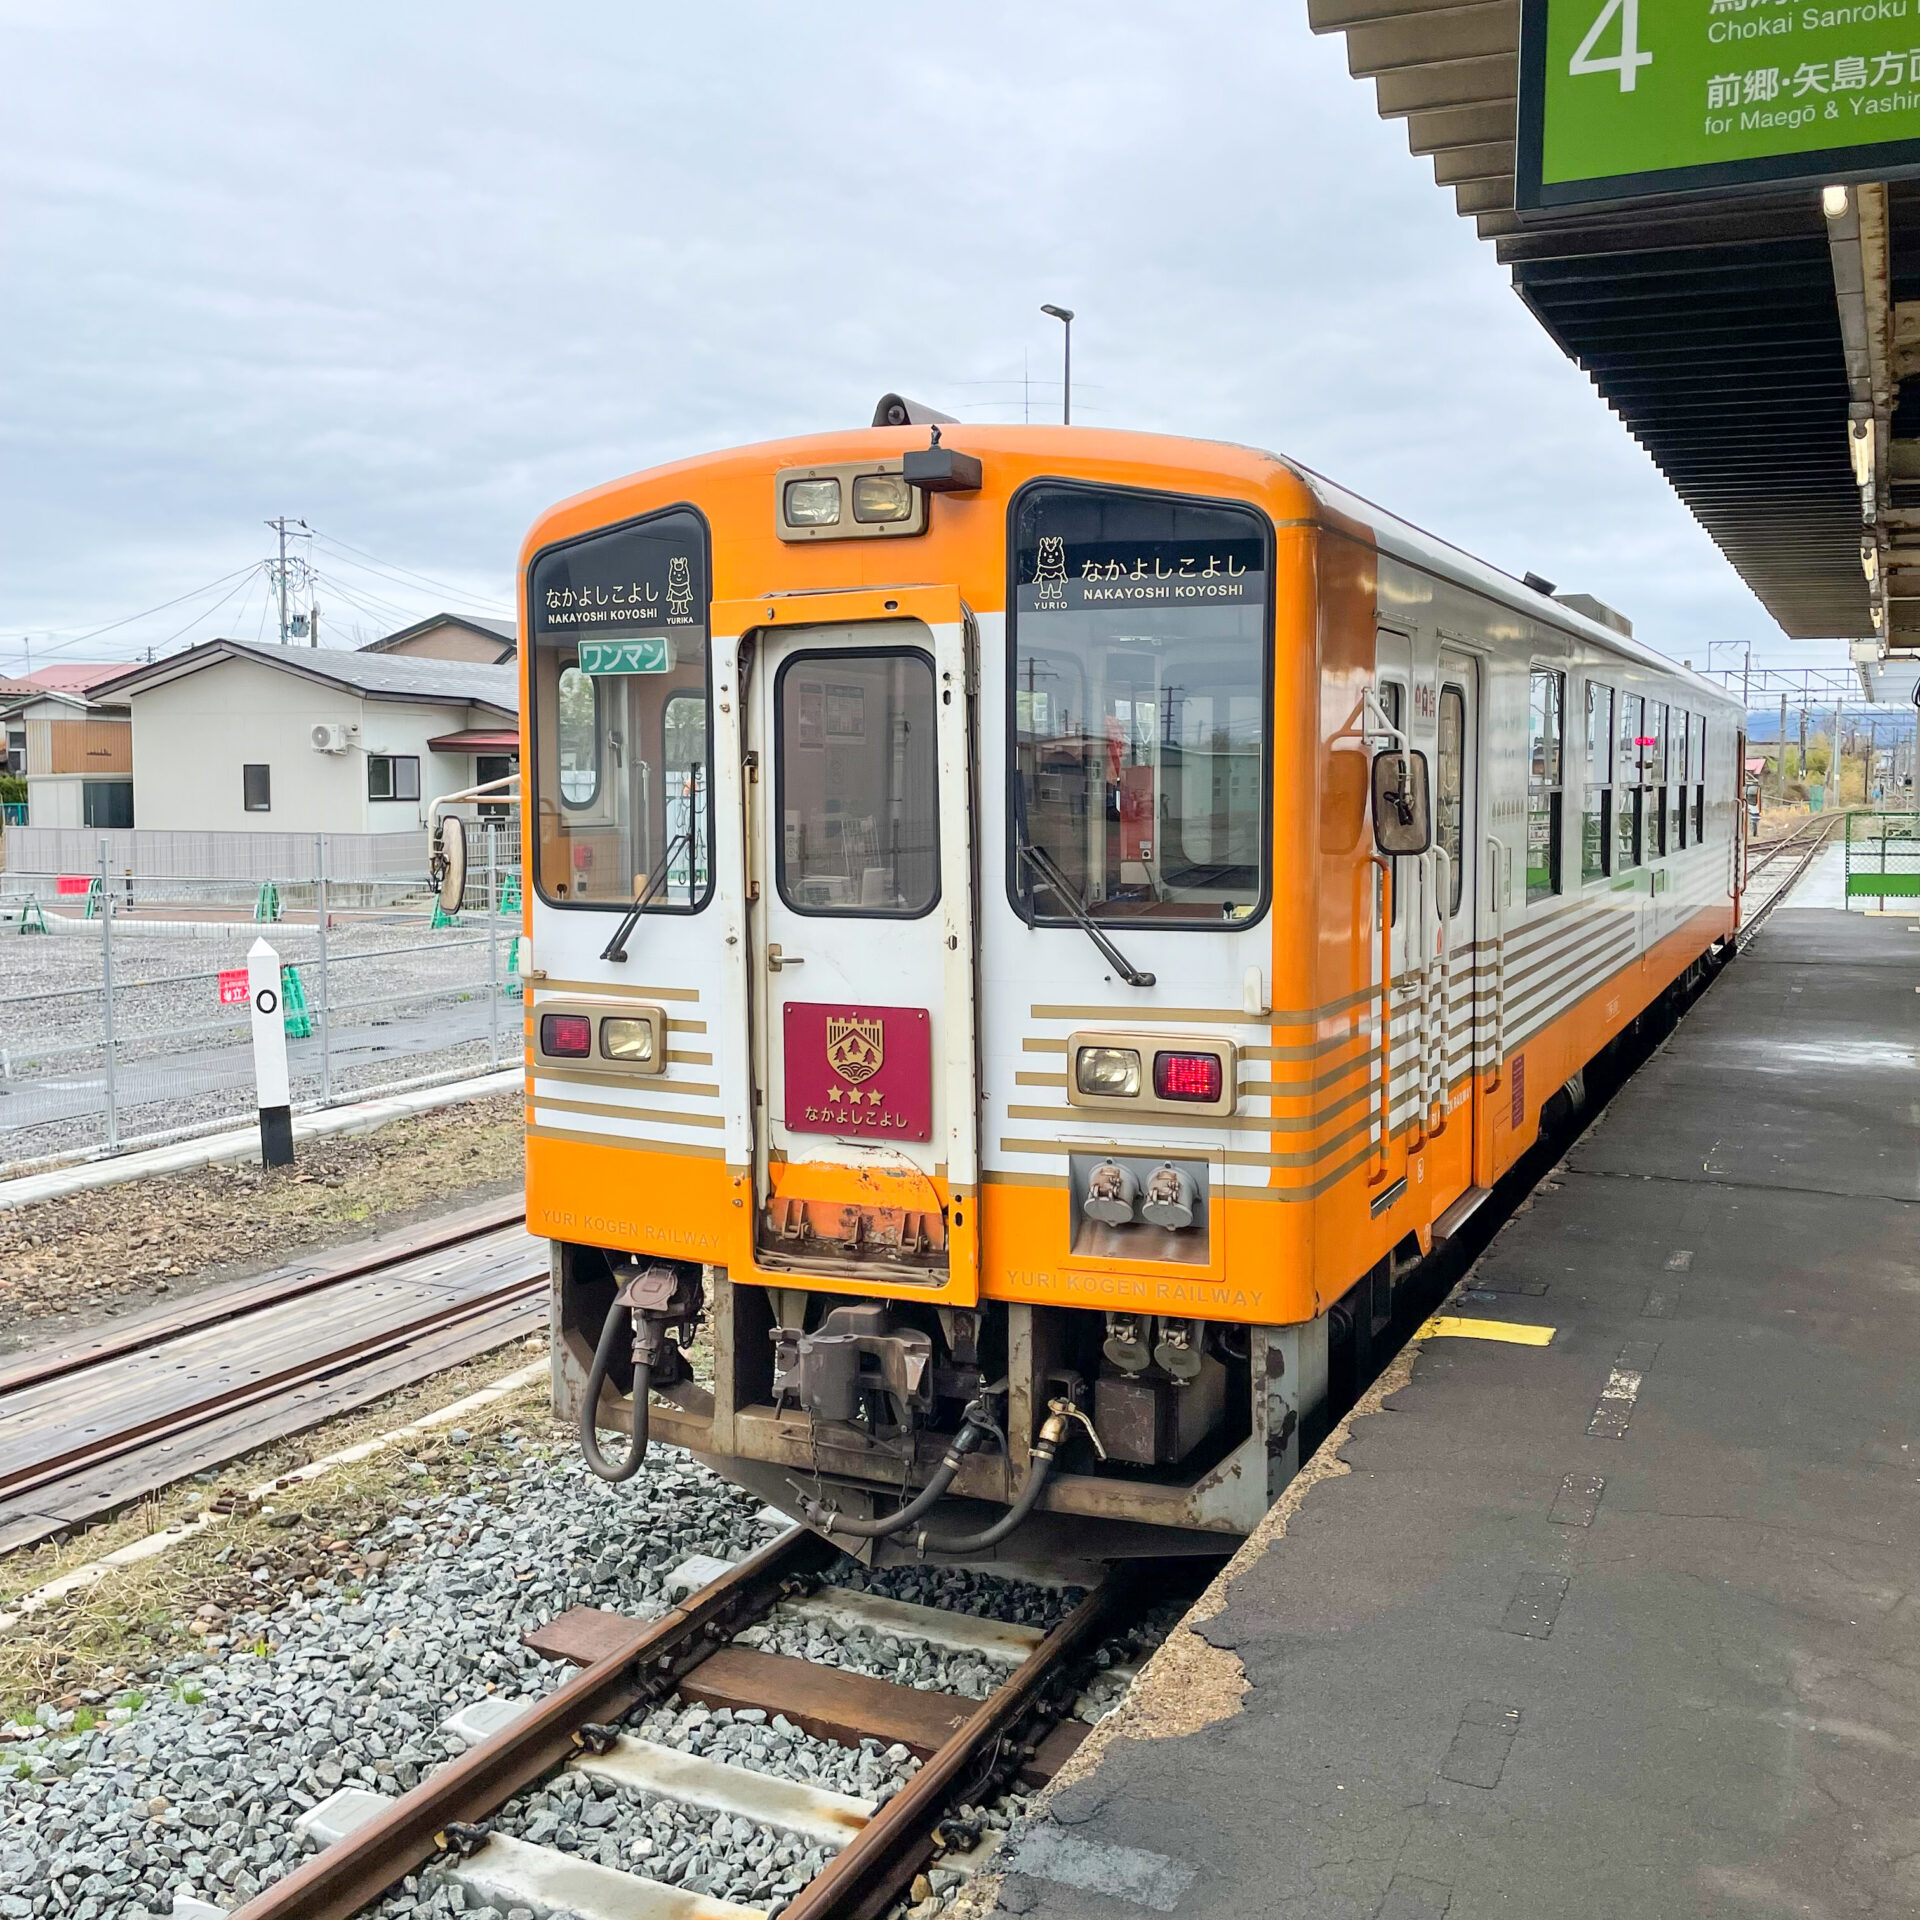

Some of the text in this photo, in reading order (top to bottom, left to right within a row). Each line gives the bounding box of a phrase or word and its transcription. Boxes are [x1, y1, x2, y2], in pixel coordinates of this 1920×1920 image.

[1708, 12, 1793, 43] Chokai
[1802, 0, 1907, 30] Sanroku
[1569, 0, 1653, 93] 4
[1704, 117, 1732, 135] for
[1740, 104, 1816, 131] Maegō
[1824, 100, 1839, 119] &
[1080, 554, 1248, 583] なかよしこよし
[545, 582, 659, 609] なかよしこよし
[1034, 601, 1068, 610] YURIO
[1083, 584, 1243, 600] NAKAYOSHI KOYOSHI
[548, 608, 658, 625] NAKAYOSHI KOYOSHI
[666, 616, 694, 626] YURIKA
[582, 643, 664, 671] ワンマン
[804, 1106, 908, 1129] なかよしこよし
[542, 1209, 720, 1249] YURI KOGEN RAILWAY
[1007, 1270, 1264, 1307] YURI KOGEN RAILWAY
